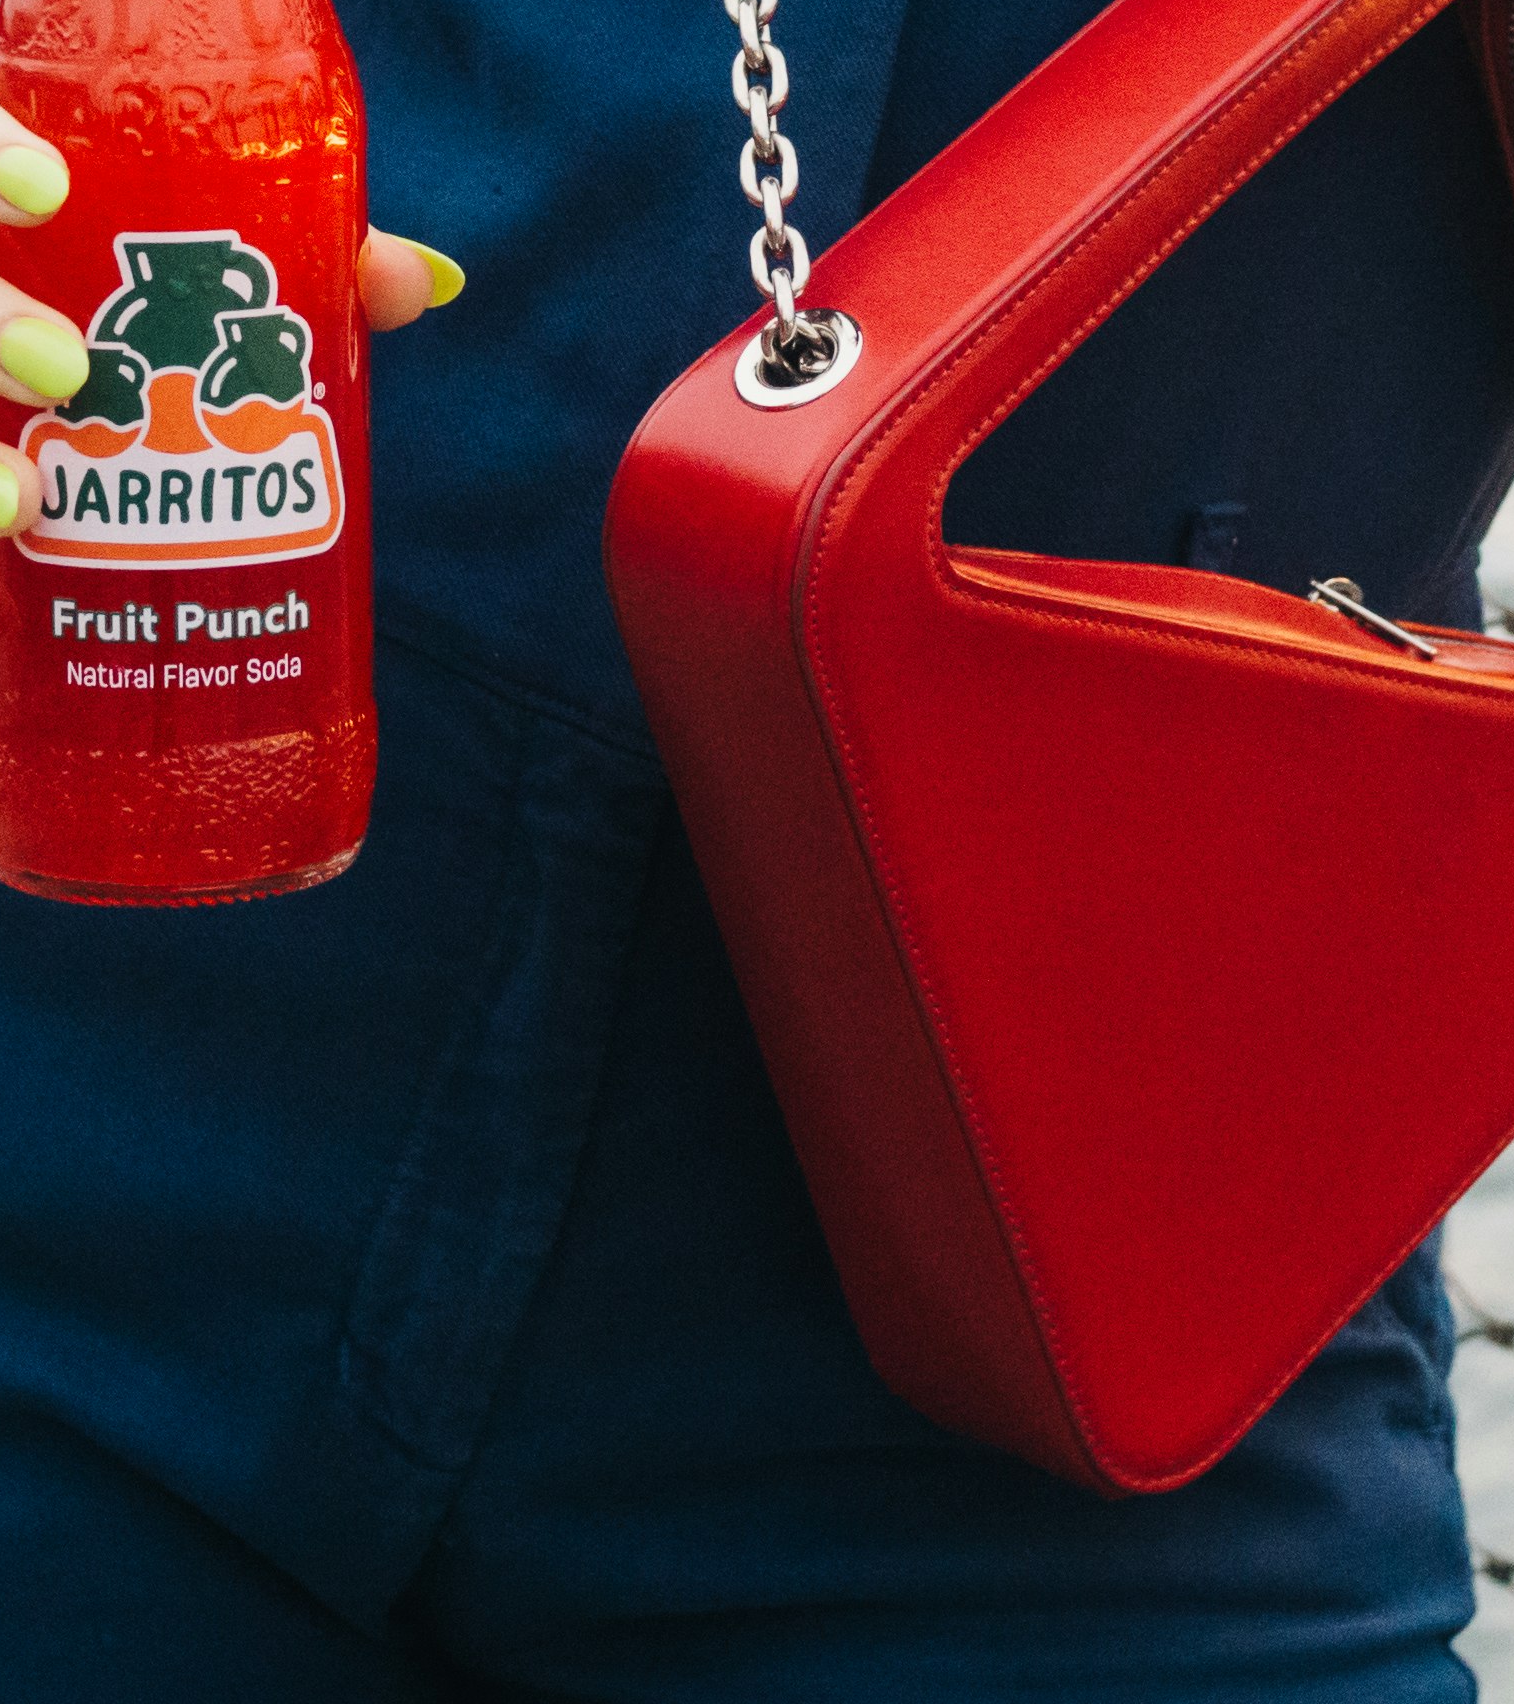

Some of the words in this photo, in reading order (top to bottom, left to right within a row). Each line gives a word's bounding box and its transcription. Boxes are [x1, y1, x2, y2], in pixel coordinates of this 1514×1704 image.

[41, 458, 316, 525] JARRITOS
[52, 598, 159, 643] Fruit
[176, 591, 309, 642] Punch
[66, 660, 154, 689] Natural
[163, 662, 238, 689] Flavor
[246, 653, 302, 684] Soda
